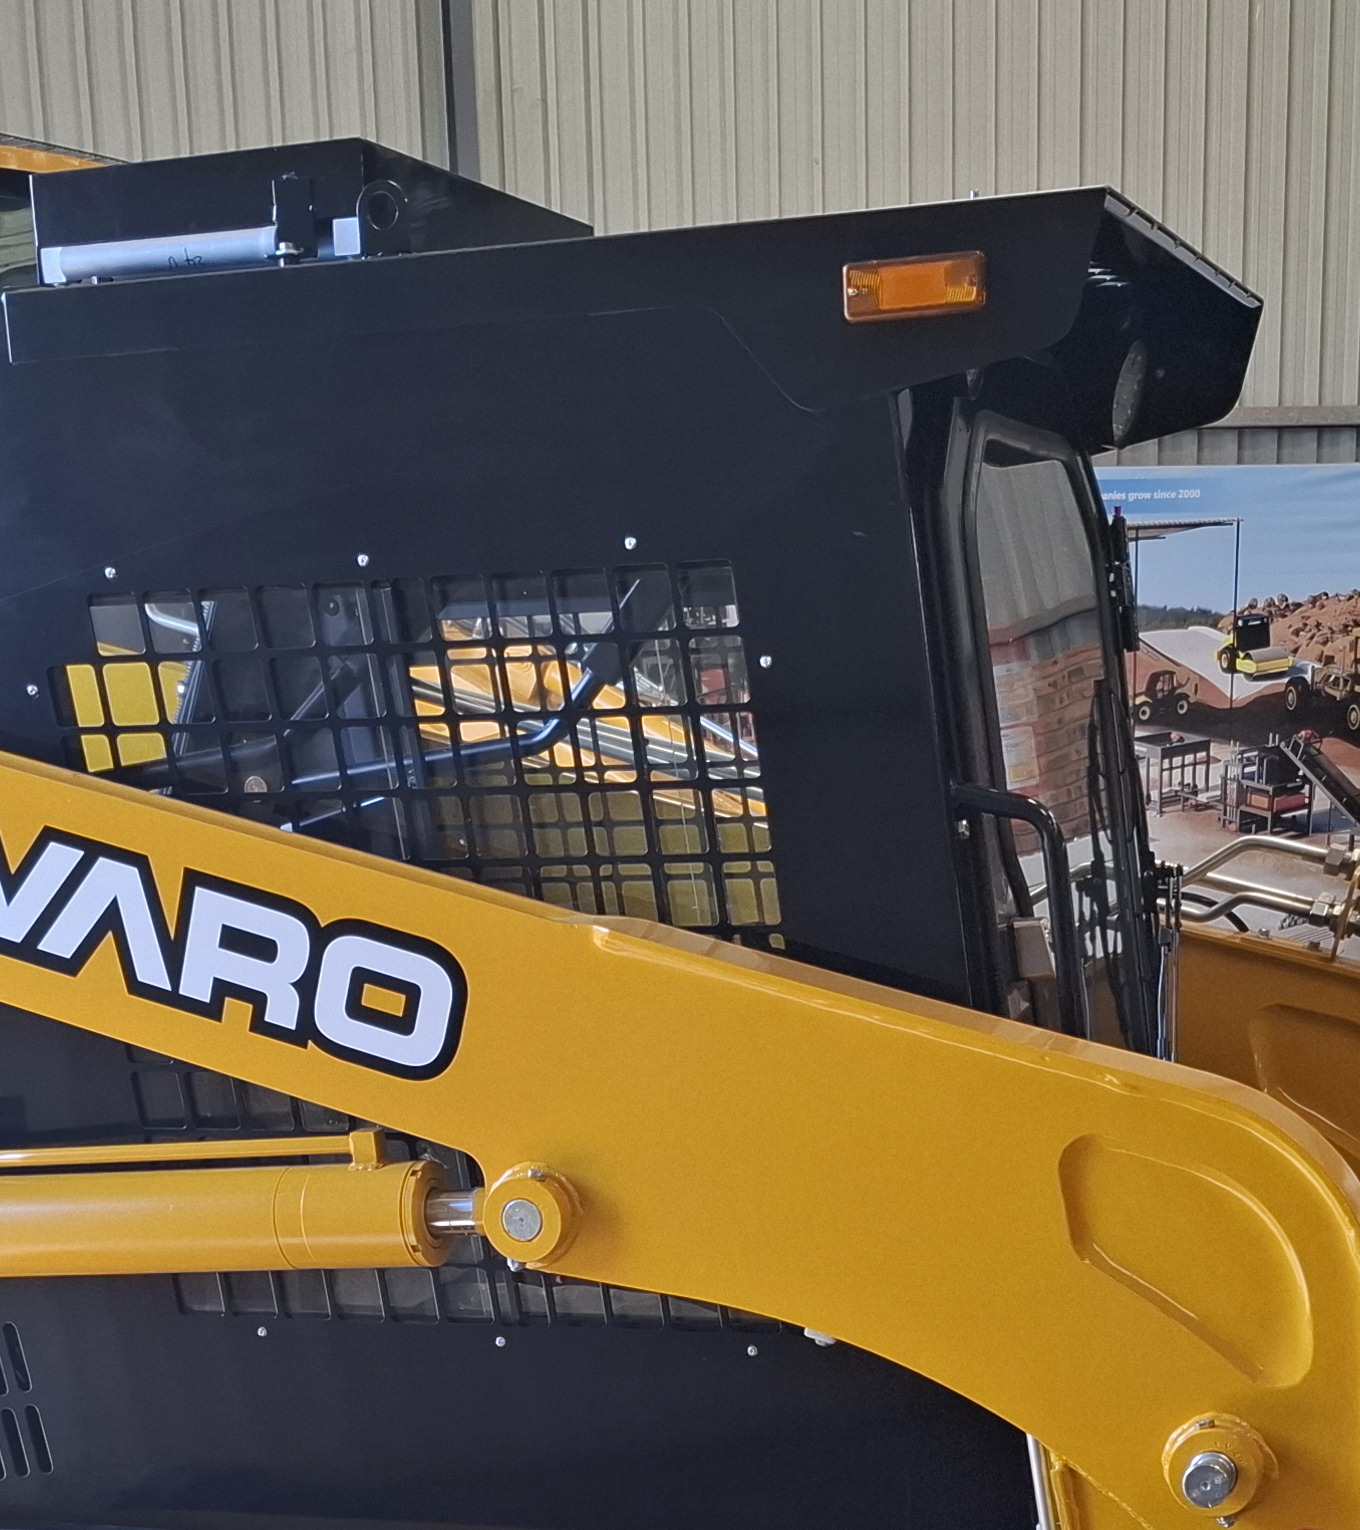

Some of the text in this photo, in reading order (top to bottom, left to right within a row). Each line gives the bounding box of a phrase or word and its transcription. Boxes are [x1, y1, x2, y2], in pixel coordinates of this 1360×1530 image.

[1101, 489, 1201, 502] anies grow since 2000
